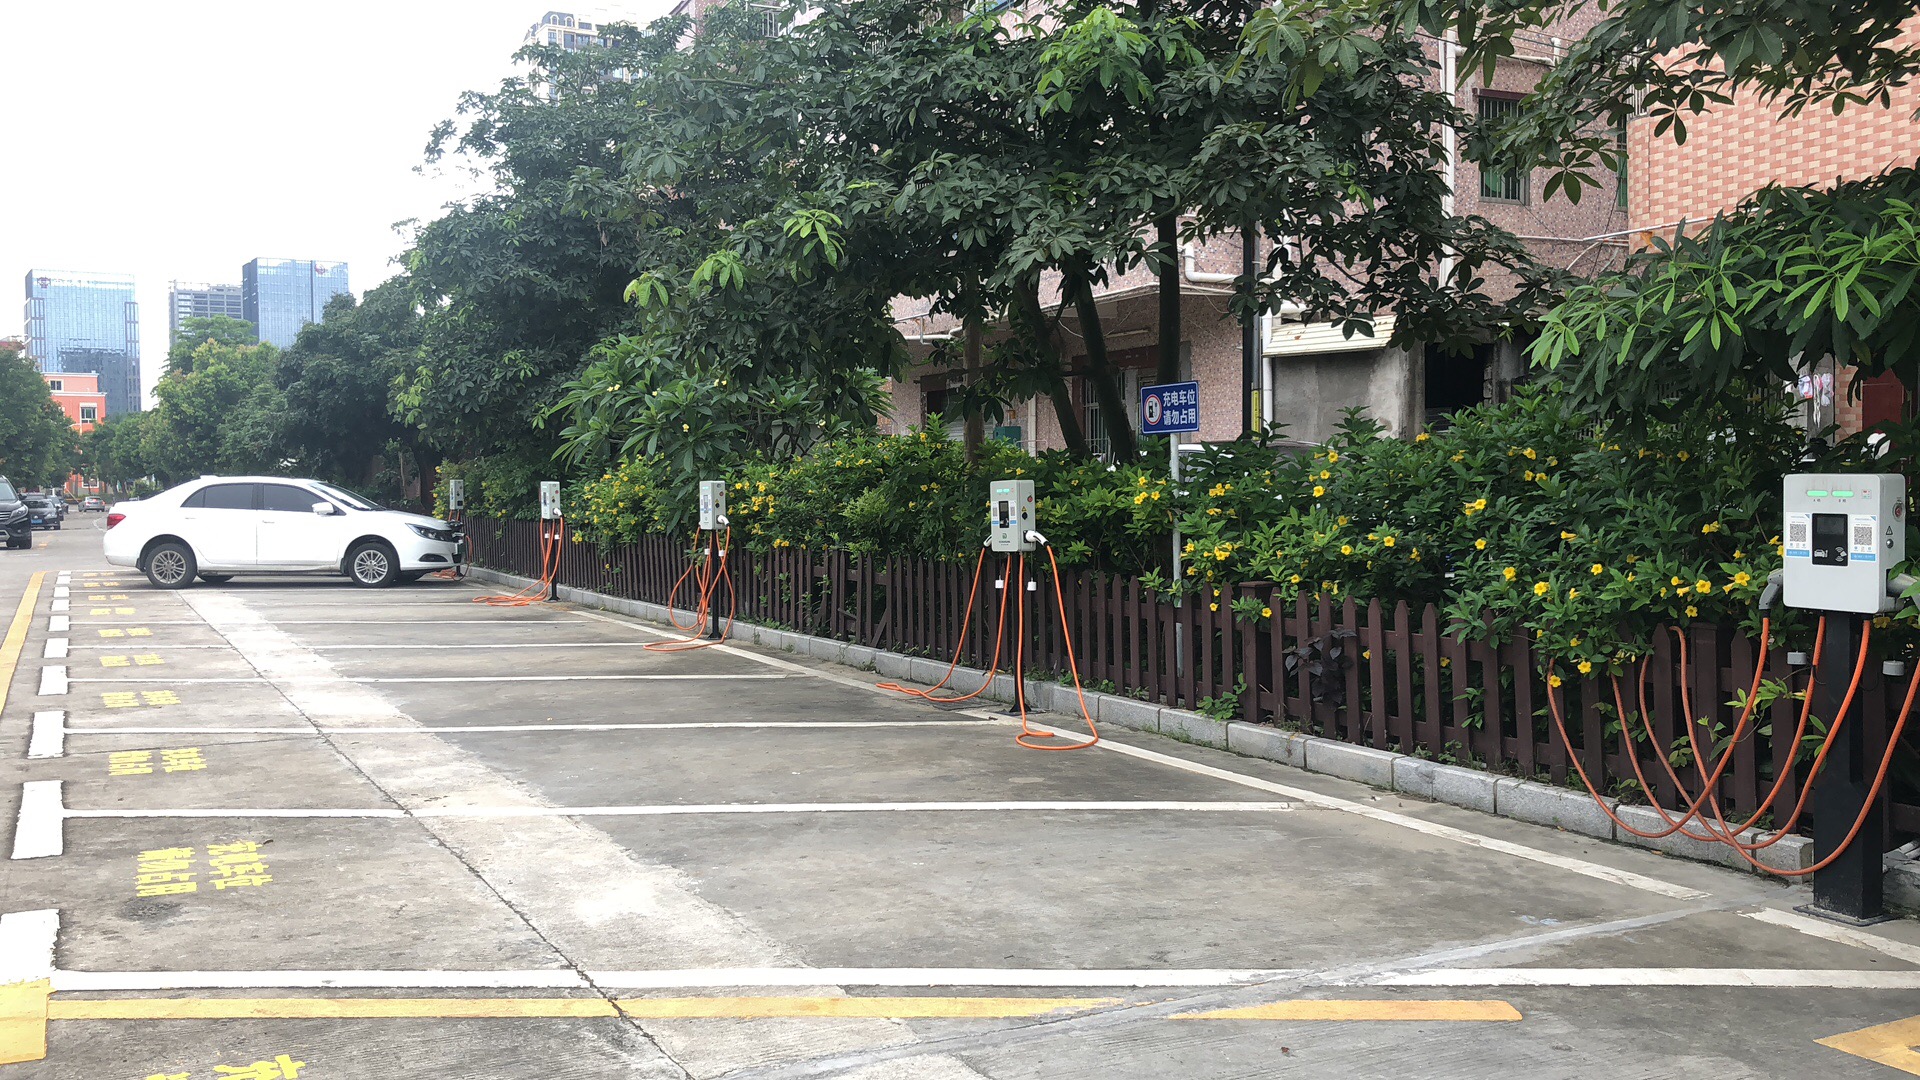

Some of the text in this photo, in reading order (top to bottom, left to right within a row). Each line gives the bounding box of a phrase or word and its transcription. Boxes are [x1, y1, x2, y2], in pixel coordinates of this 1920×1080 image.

[1163, 389, 1196, 407] 充电车位
[1163, 408, 1196, 426] 请勿占用
